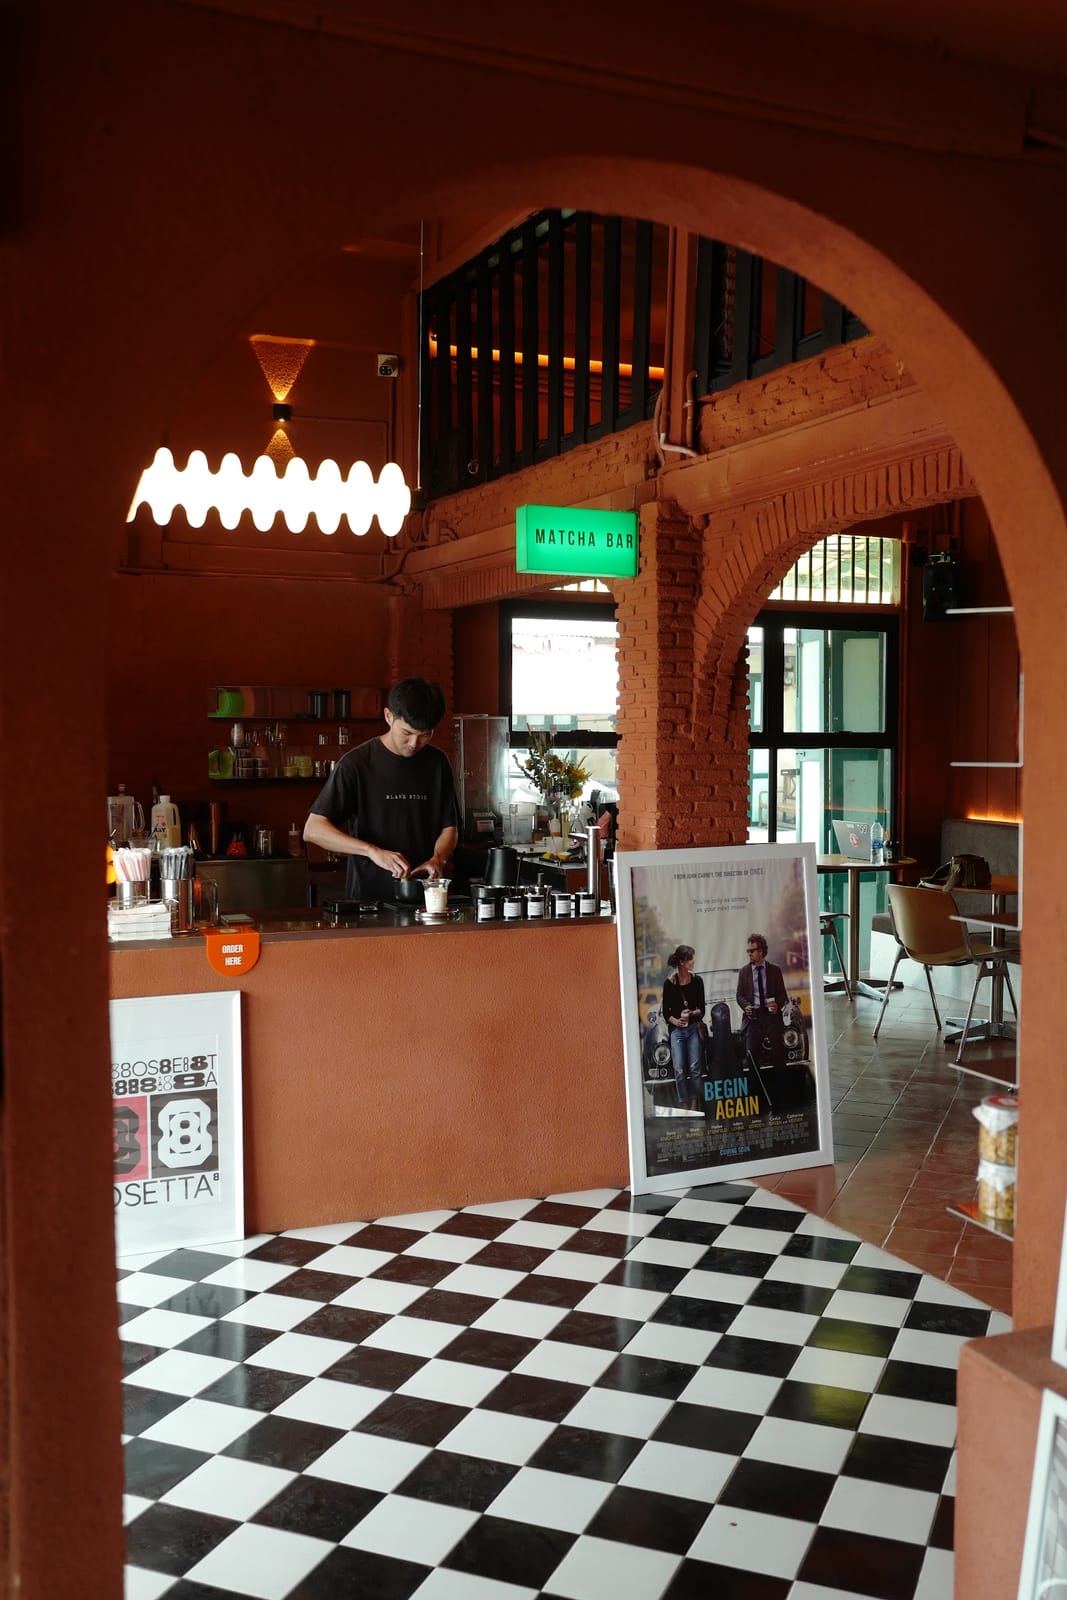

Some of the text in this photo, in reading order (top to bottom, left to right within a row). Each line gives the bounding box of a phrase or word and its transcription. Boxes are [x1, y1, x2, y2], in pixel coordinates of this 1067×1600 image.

[535, 528, 633, 549] MATCHA BAR
[222, 944, 244, 954] ORDER
[225, 956, 242, 966] HERE
[704, 1076, 748, 1101] BEGIN
[716, 1095, 760, 1120] AGAIN
